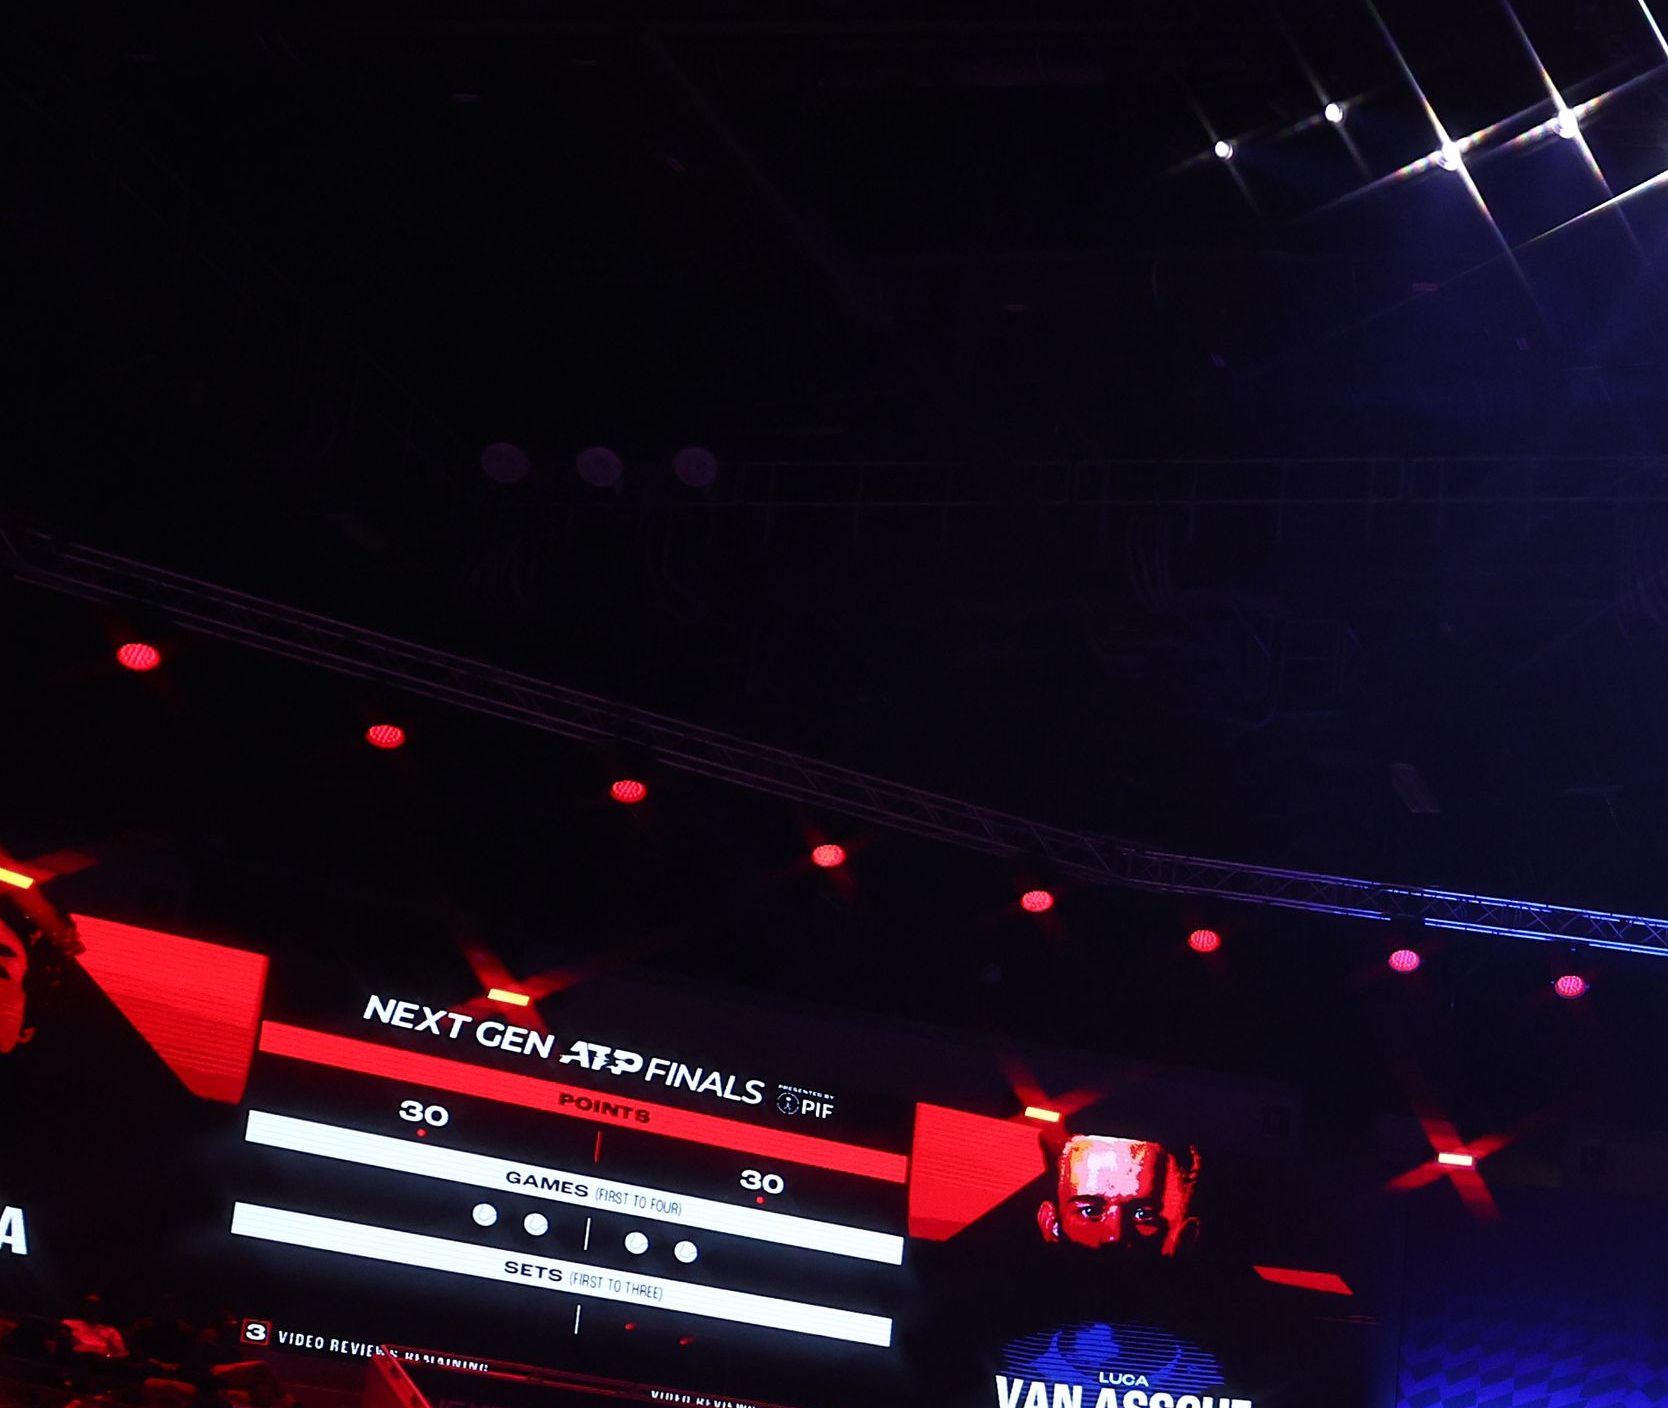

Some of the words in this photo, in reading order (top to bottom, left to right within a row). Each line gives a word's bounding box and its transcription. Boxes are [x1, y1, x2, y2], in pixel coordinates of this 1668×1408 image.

[363, 995, 472, 1039] NEXT
[475, 1021, 555, 1059] GEN
[558, 1041, 644, 1075] ATP
[644, 1057, 765, 1105] FINALS
[399, 1100, 449, 1127] 30
[558, 1093, 650, 1124] POINTS
[801, 1099, 834, 1119] PIF
[506, 1171, 589, 1197] GAMES
[595, 1187, 628, 1205] (FIRST
[634, 1195, 647, 1209] TO
[650, 1201, 682, 1217] FOUR)
[739, 1169, 784, 1195] 30
[504, 1261, 563, 1281] SETS
[569, 1271, 603, 1288] (FIRST
[608, 1279, 621, 1293] TO
[626, 1281, 663, 1301] THREE)
[246, 1324, 266, 1340] 3
[278, 1330, 324, 1350] VIDEO
[1099, 1371, 1149, 1387] LUCA
